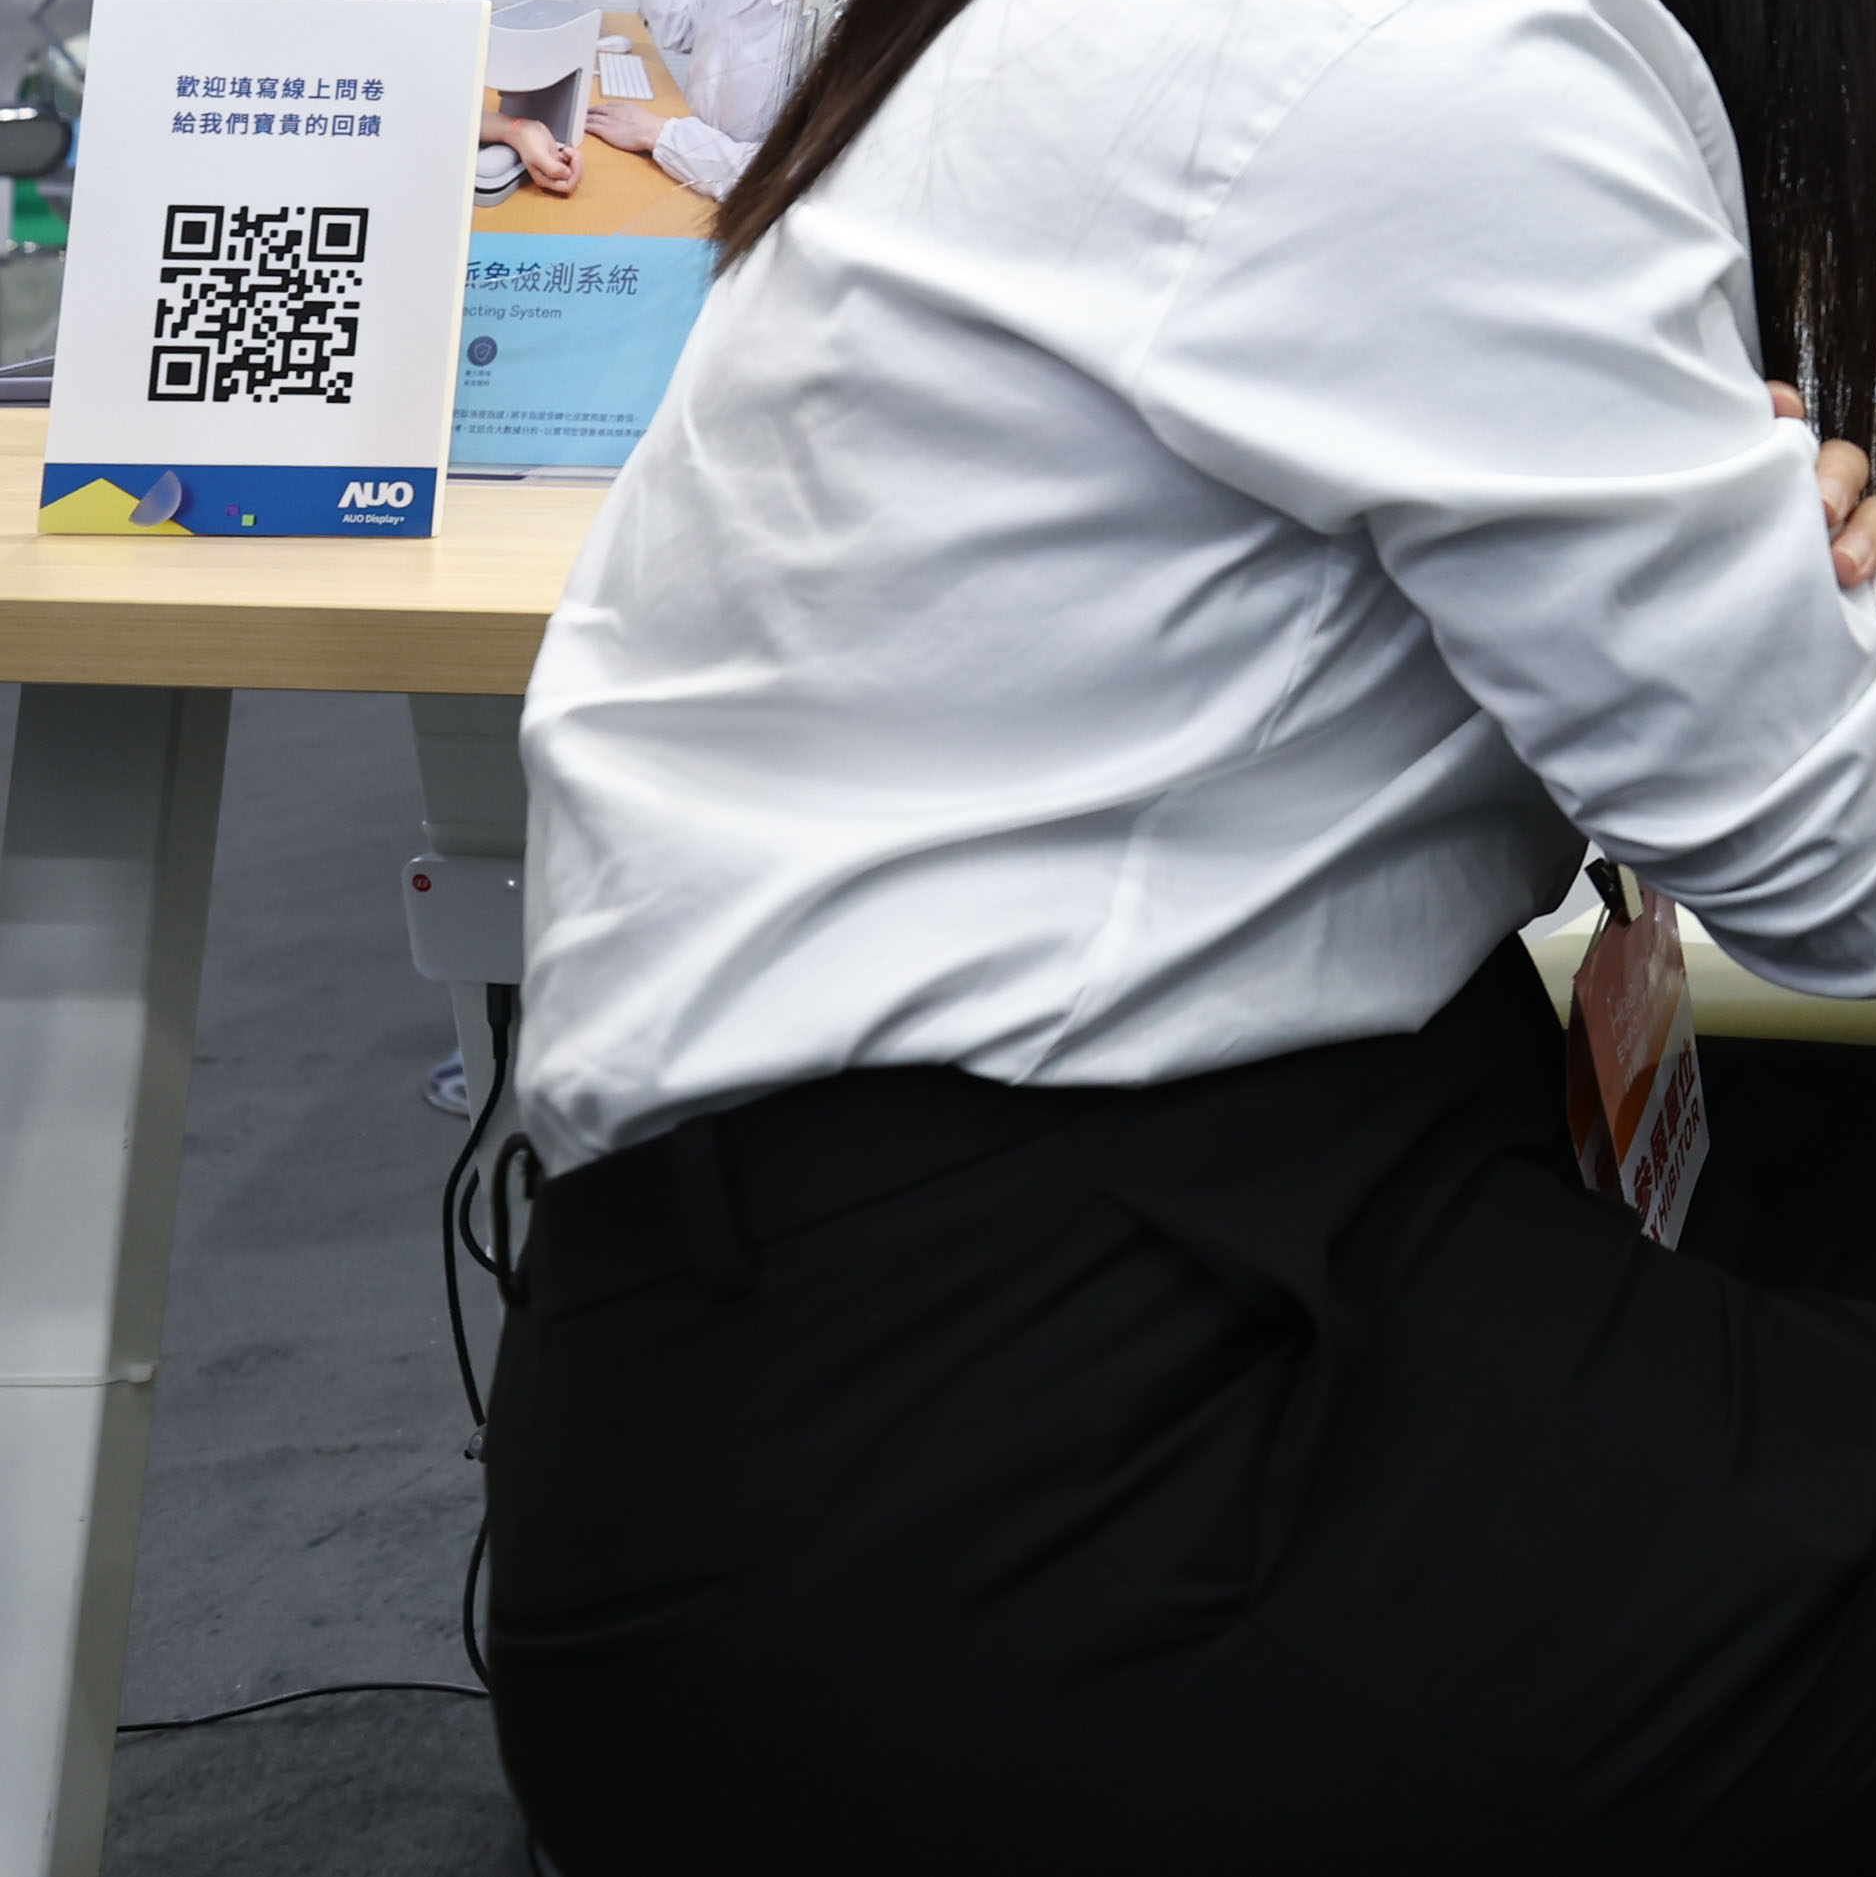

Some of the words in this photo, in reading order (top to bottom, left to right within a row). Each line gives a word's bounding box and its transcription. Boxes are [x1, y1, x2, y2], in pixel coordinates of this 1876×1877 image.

[175, 74, 385, 102] 歡迎填寫線上問卷
[171, 111, 382, 137] 給我們寶貴的回饋
[462, 304, 506, 319] ecting
[509, 304, 563, 320] System
[337, 481, 414, 509] AUO
[342, 514, 365, 523] AUO
[1646, 1095, 1701, 1242] XHIBITOR
